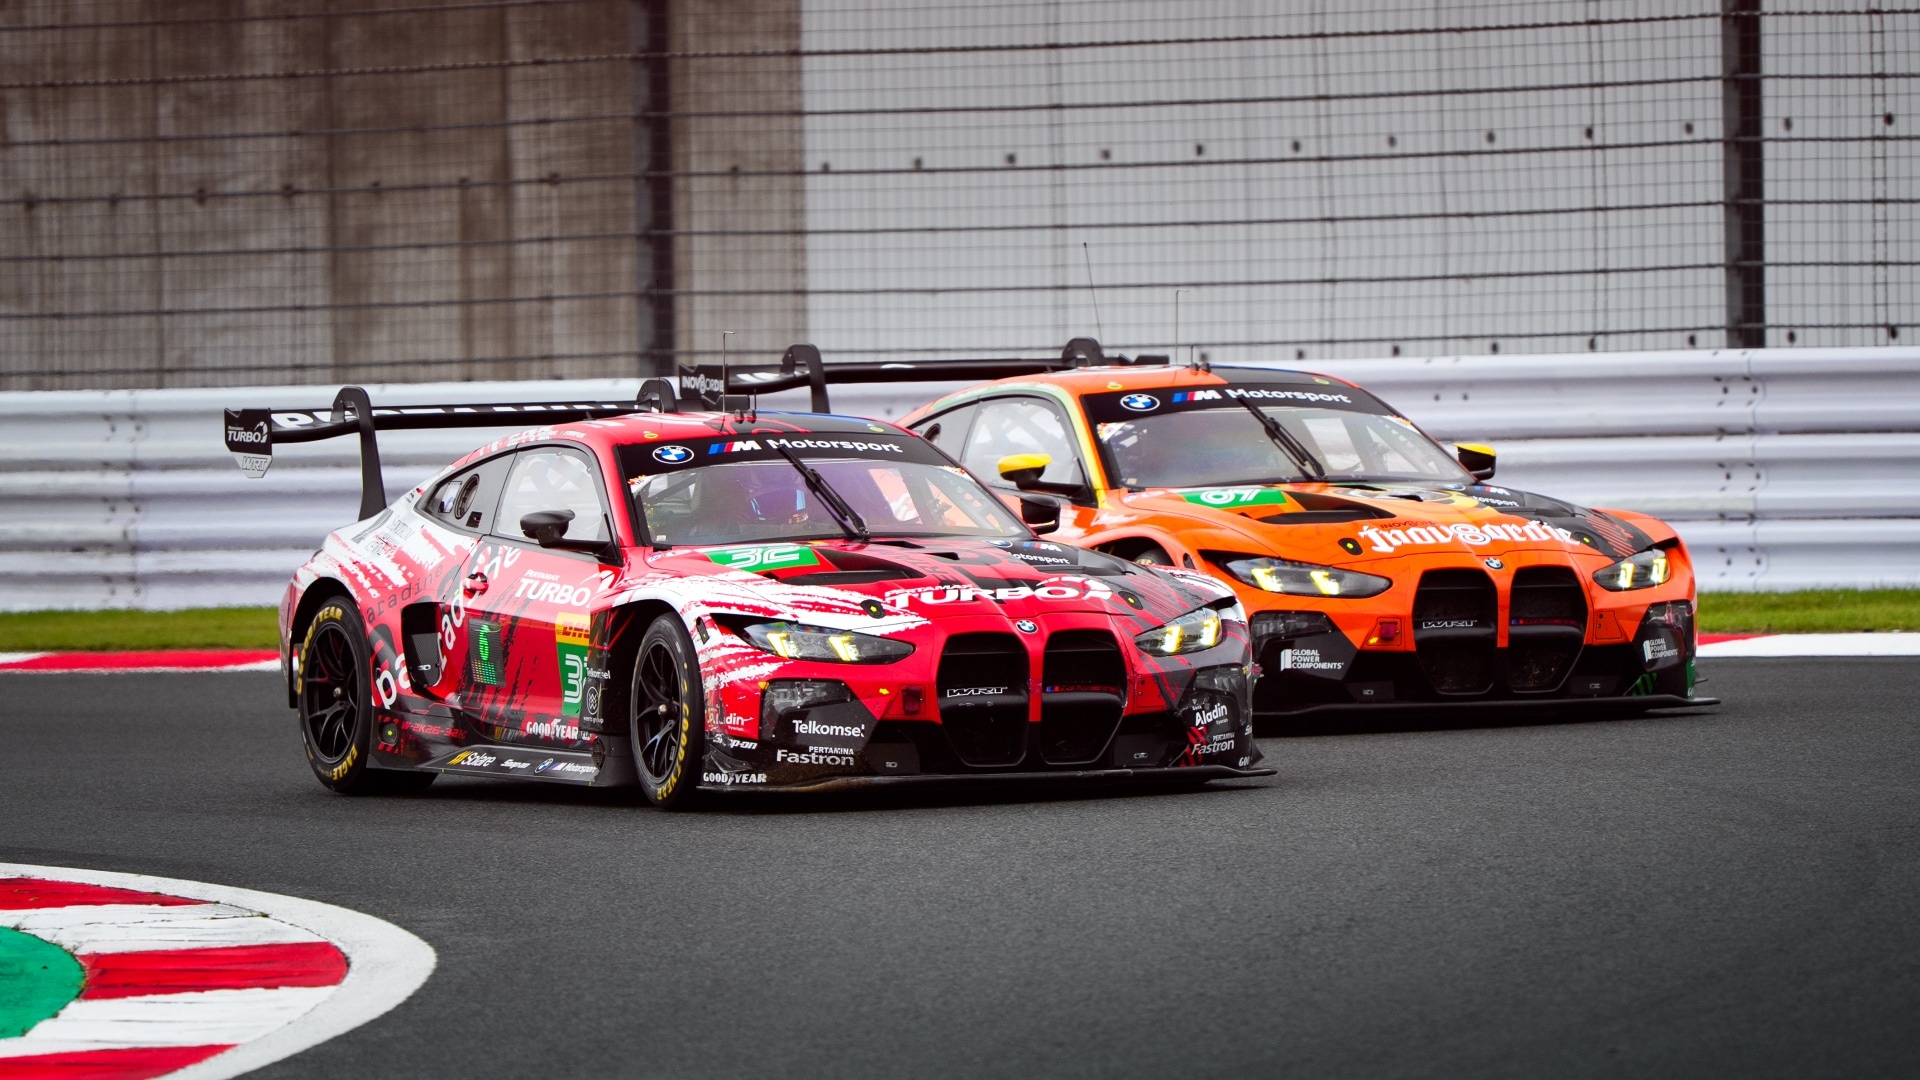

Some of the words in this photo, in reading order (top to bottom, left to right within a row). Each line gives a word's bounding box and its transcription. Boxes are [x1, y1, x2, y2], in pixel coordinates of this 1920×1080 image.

[1225, 389, 1352, 403] Motorsport
[228, 431, 261, 443] TURBO
[766, 439, 903, 452] Motorsport
[242, 456, 268, 472] WRT
[724, 546, 801, 568] 32
[1012, 553, 1070, 565] otorsport
[515, 578, 592, 607] TURBO
[885, 586, 1080, 609] TURBO
[1422, 620, 1477, 629] WRT
[1292, 662, 1342, 670] COMPONENTS
[564, 654, 587, 703] 3
[947, 686, 1008, 698] WRT
[1195, 703, 1227, 726] Aladin
[526, 718, 579, 740] GOODYEAR
[792, 720, 865, 737] Telkomsel
[809, 746, 854, 755] PERTAMINA
[1191, 740, 1235, 755] Fastron
[776, 749, 855, 766] Fastron
[703, 773, 768, 785] GOODYEAR
